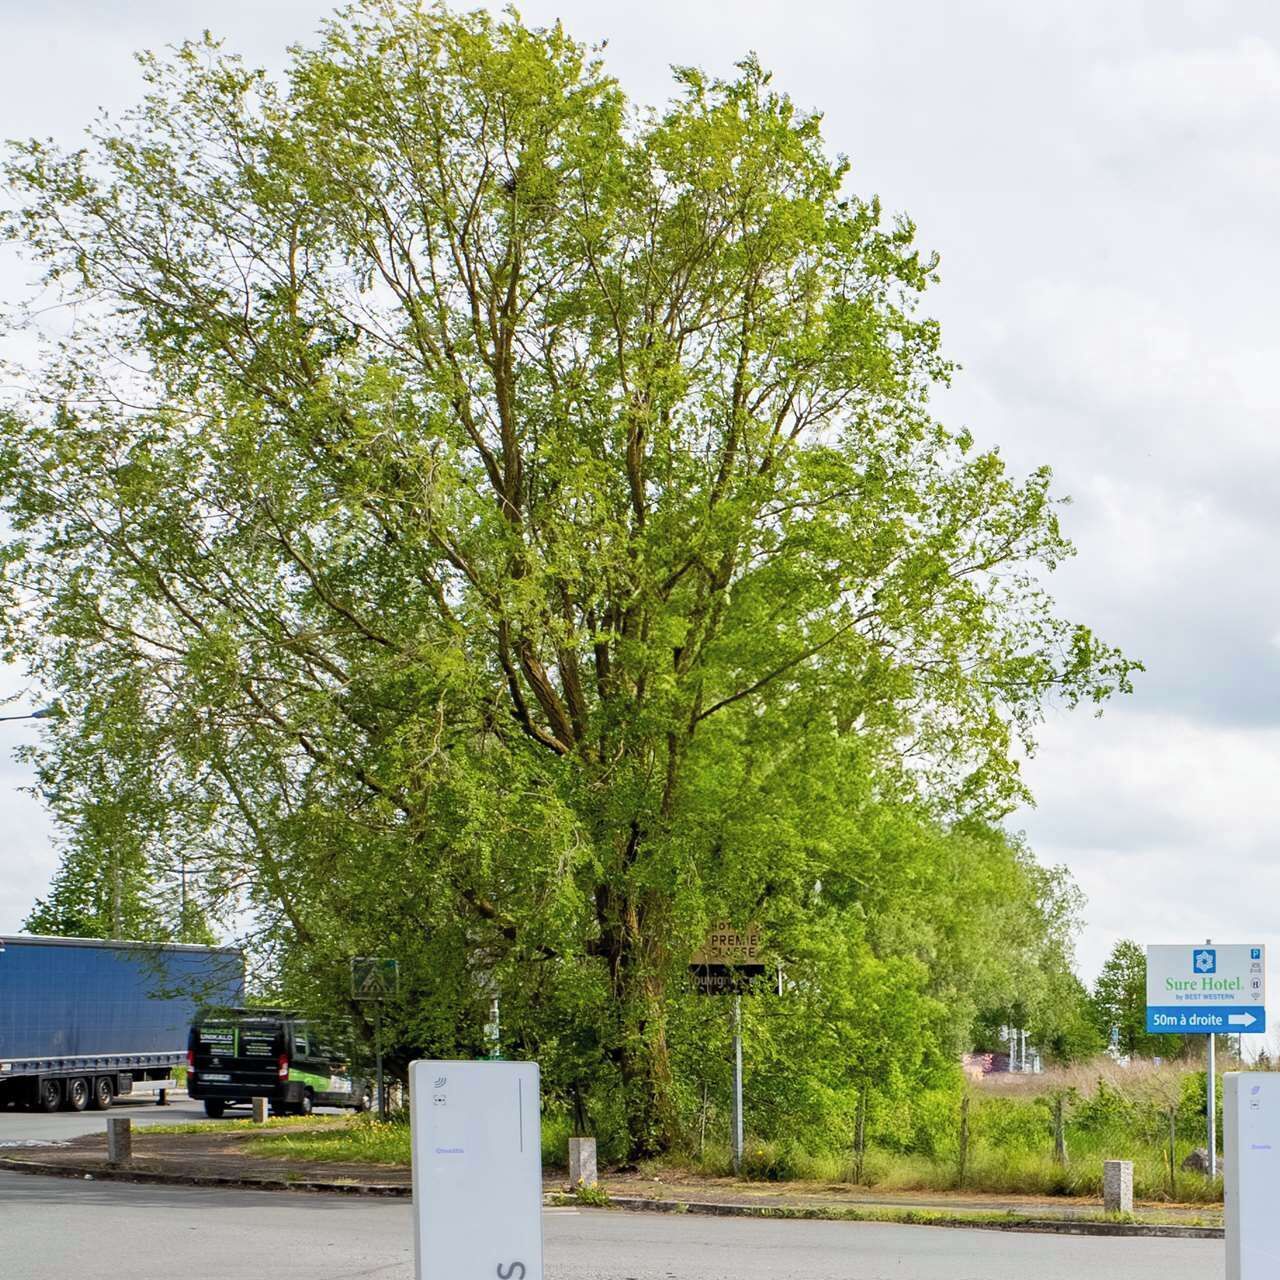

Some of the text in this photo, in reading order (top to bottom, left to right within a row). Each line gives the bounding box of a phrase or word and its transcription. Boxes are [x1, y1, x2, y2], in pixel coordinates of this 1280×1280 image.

[712, 935, 760, 946] PREMIE
[1165, 977, 1197, 991] Sure
[1153, 1012, 1223, 1026] 50m à droite
